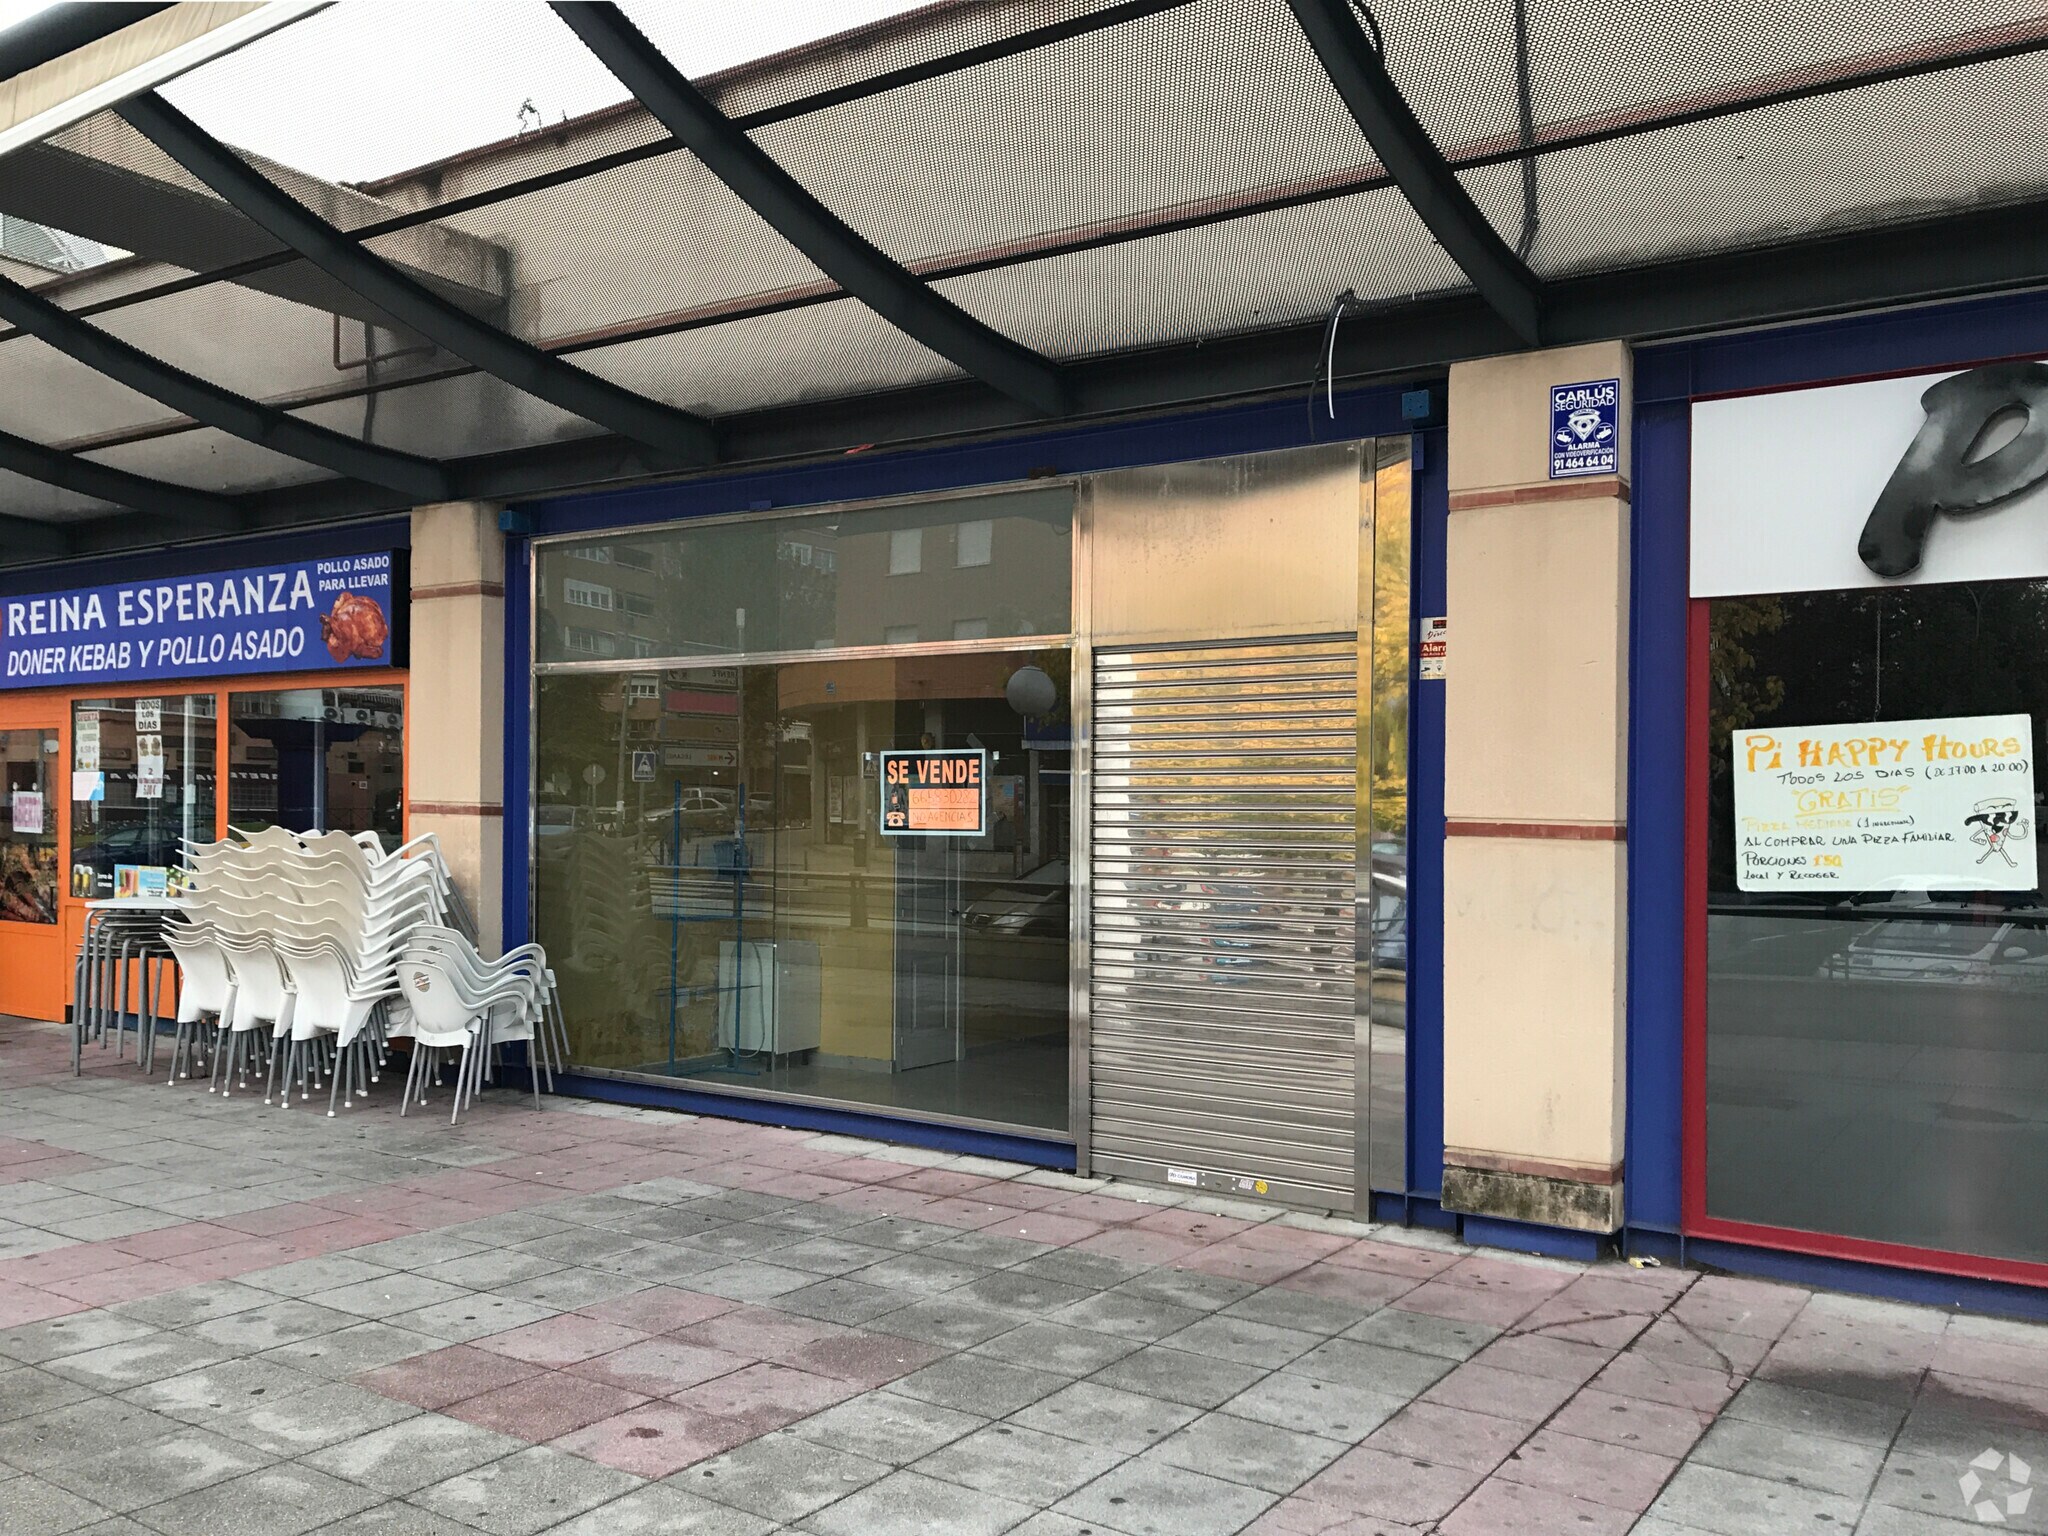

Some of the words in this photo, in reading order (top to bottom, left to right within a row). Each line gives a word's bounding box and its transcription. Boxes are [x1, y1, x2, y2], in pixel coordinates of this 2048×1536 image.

[1555, 385, 1614, 403] CARLÚS
[1554, 396, 1615, 412] SEGURIDAD
[1567, 441, 1600, 451] ALARMA
[1554, 459, 1564, 470] 91
[1565, 456, 1584, 468] 464
[1586, 455, 1599, 466] 64
[1601, 454, 1614, 464] 04
[317, 560, 351, 575] POLLO
[353, 555, 389, 571] ASADO
[319, 577, 346, 591] PARA
[348, 573, 388, 588] LLEVAR
[8, 594, 105, 637] REINA
[118, 569, 315, 627] ESPERANZA
[7, 646, 67, 677] DONER
[69, 641, 131, 673] KEBAB
[138, 639, 154, 668] Y
[158, 633, 225, 667] POLLO
[228, 626, 305, 660] ASADO
[136, 699, 160, 710] TODOS
[142, 710, 155, 719] LOS
[1798, 737, 1910, 768] HAPPY
[148, 767, 153, 775] 2
[887, 760, 909, 784] SE
[916, 759, 979, 784] VENDE
[1777, 771, 1825, 785] TODOS
[1834, 770, 1865, 783] LOS
[1875, 768, 1915, 778] DIAS
[912, 811, 926, 822] NO
[928, 811, 974, 823] AGENCIAS
[1744, 837, 1761, 847] AL
[1765, 836, 1826, 847] COMPRAR
[1832, 835, 1857, 845] UNA
[1861, 833, 1899, 844] PIZZA
[1741, 851, 1807, 866] PORCIONES
